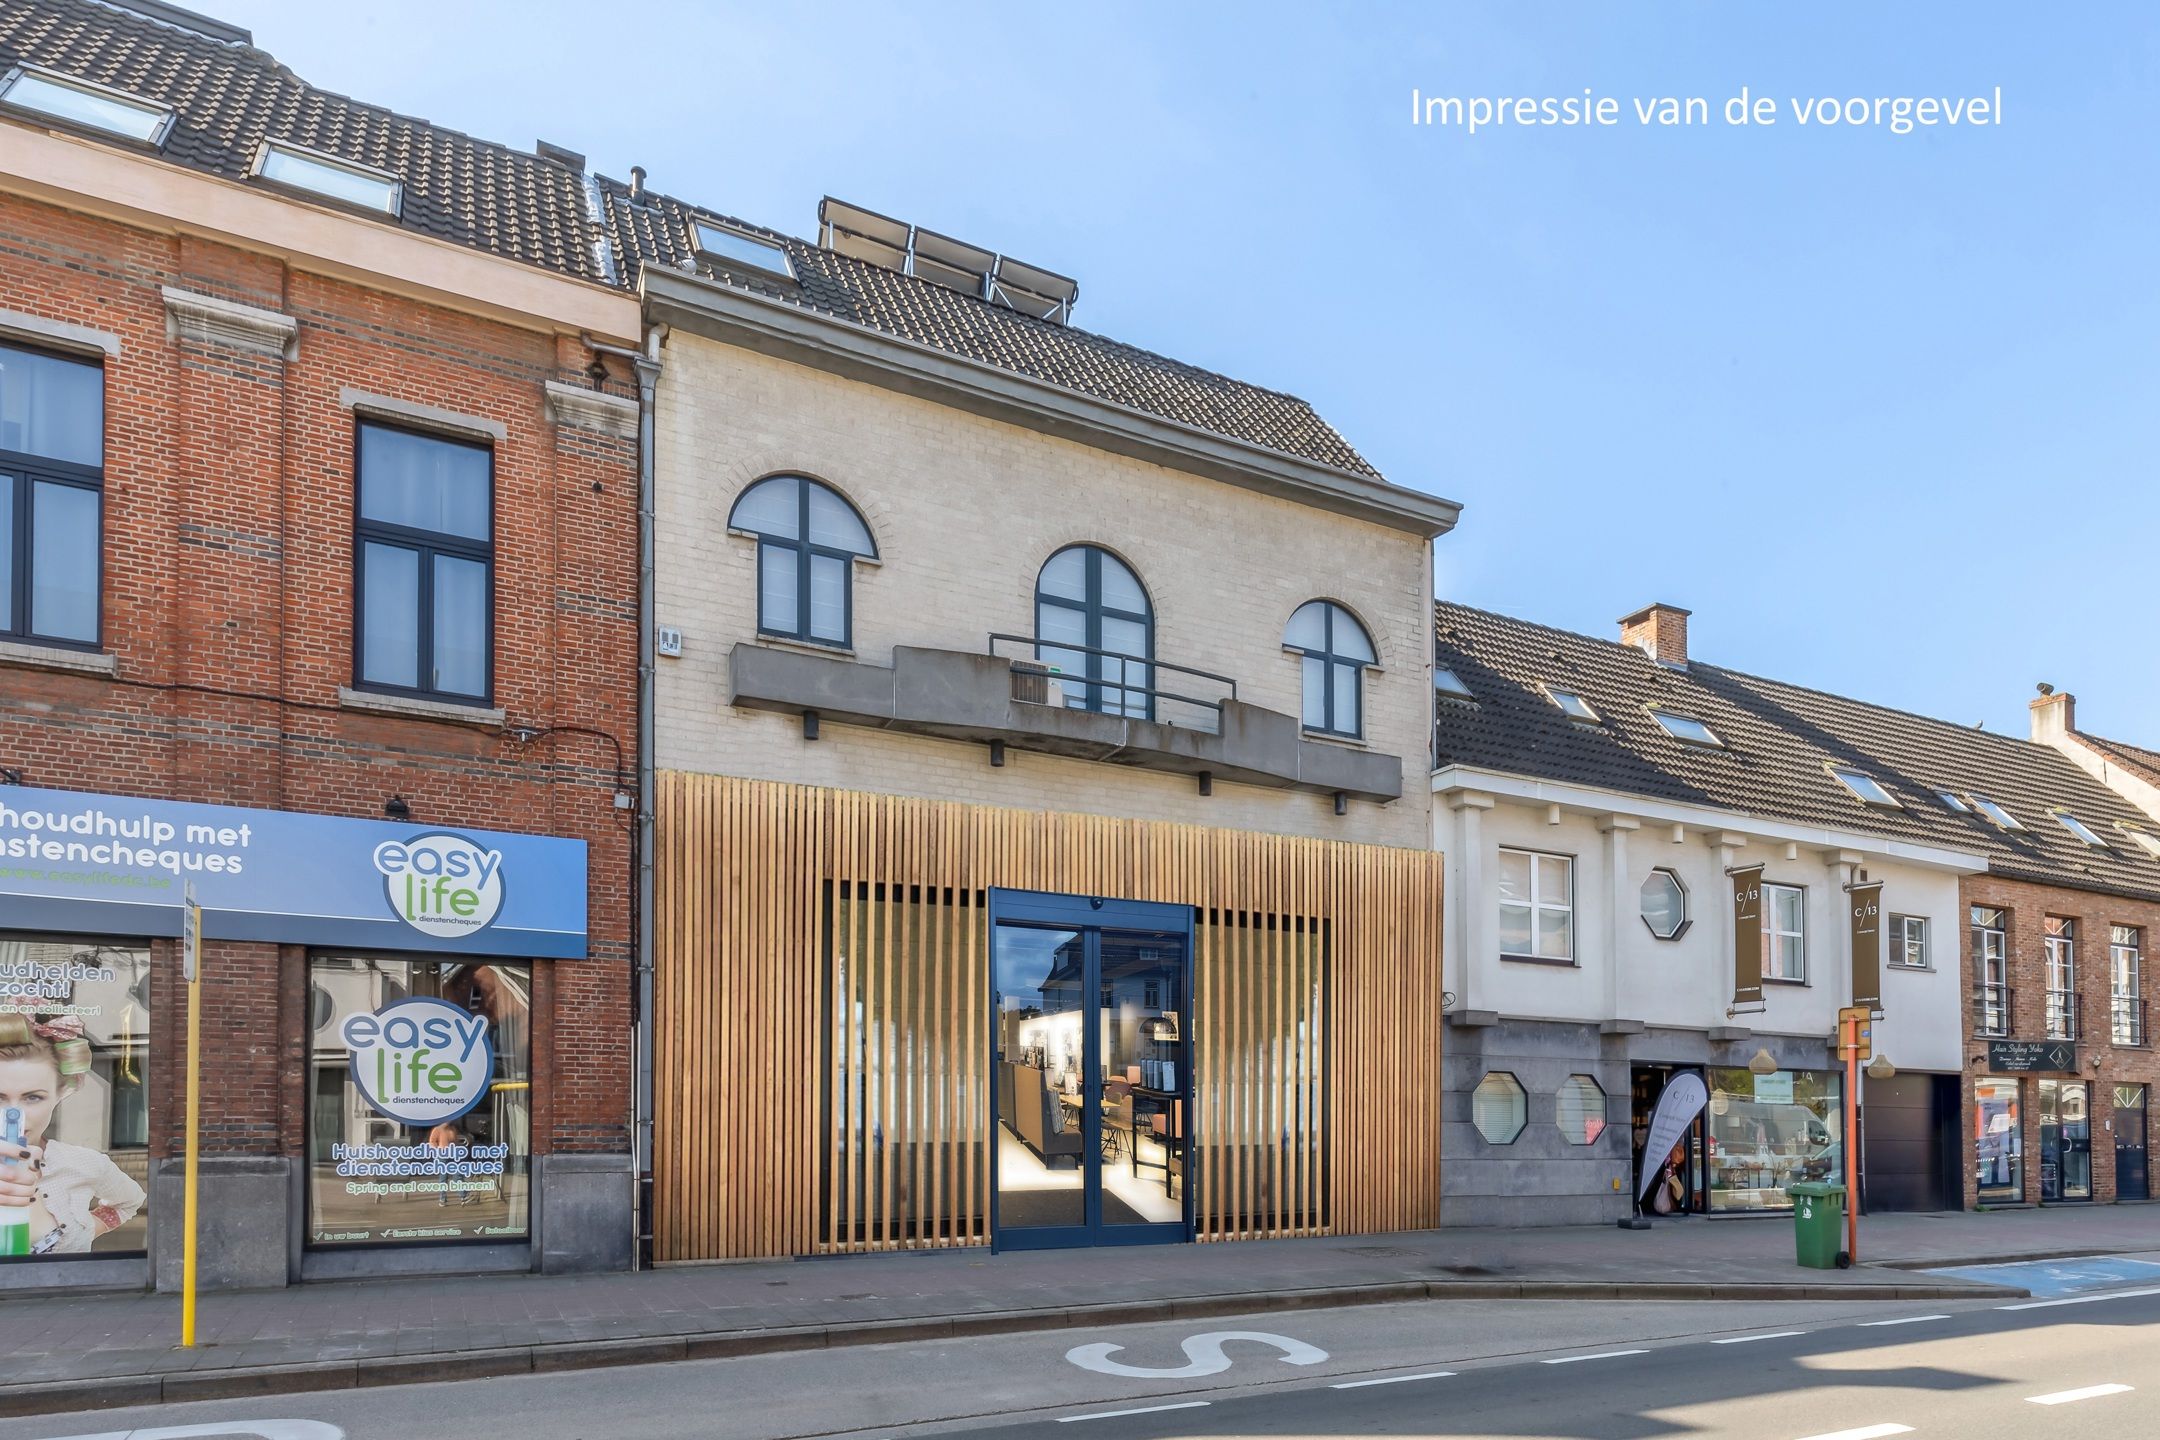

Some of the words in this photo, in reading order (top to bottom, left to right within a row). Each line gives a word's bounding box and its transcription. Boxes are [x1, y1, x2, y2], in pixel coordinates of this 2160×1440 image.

[187, 824, 252, 847] met
[379, 845, 497, 890] easy
[406, 873, 479, 921] life
[418, 914, 483, 927] dienstencheques
[344, 1016, 484, 1062] easy
[377, 1048, 462, 1103] life
[392, 1096, 466, 1106] dienstencheques
[332, 1143, 469, 1162] Huishoudhulp
[472, 1143, 509, 1159] met
[336, 1159, 503, 1177] dienstencheques
[346, 1182, 388, 1195] Spring
[390, 1181, 417, 1193] snel
[418, 1182, 448, 1192] even
[450, 1178, 496, 1191] binnen!
